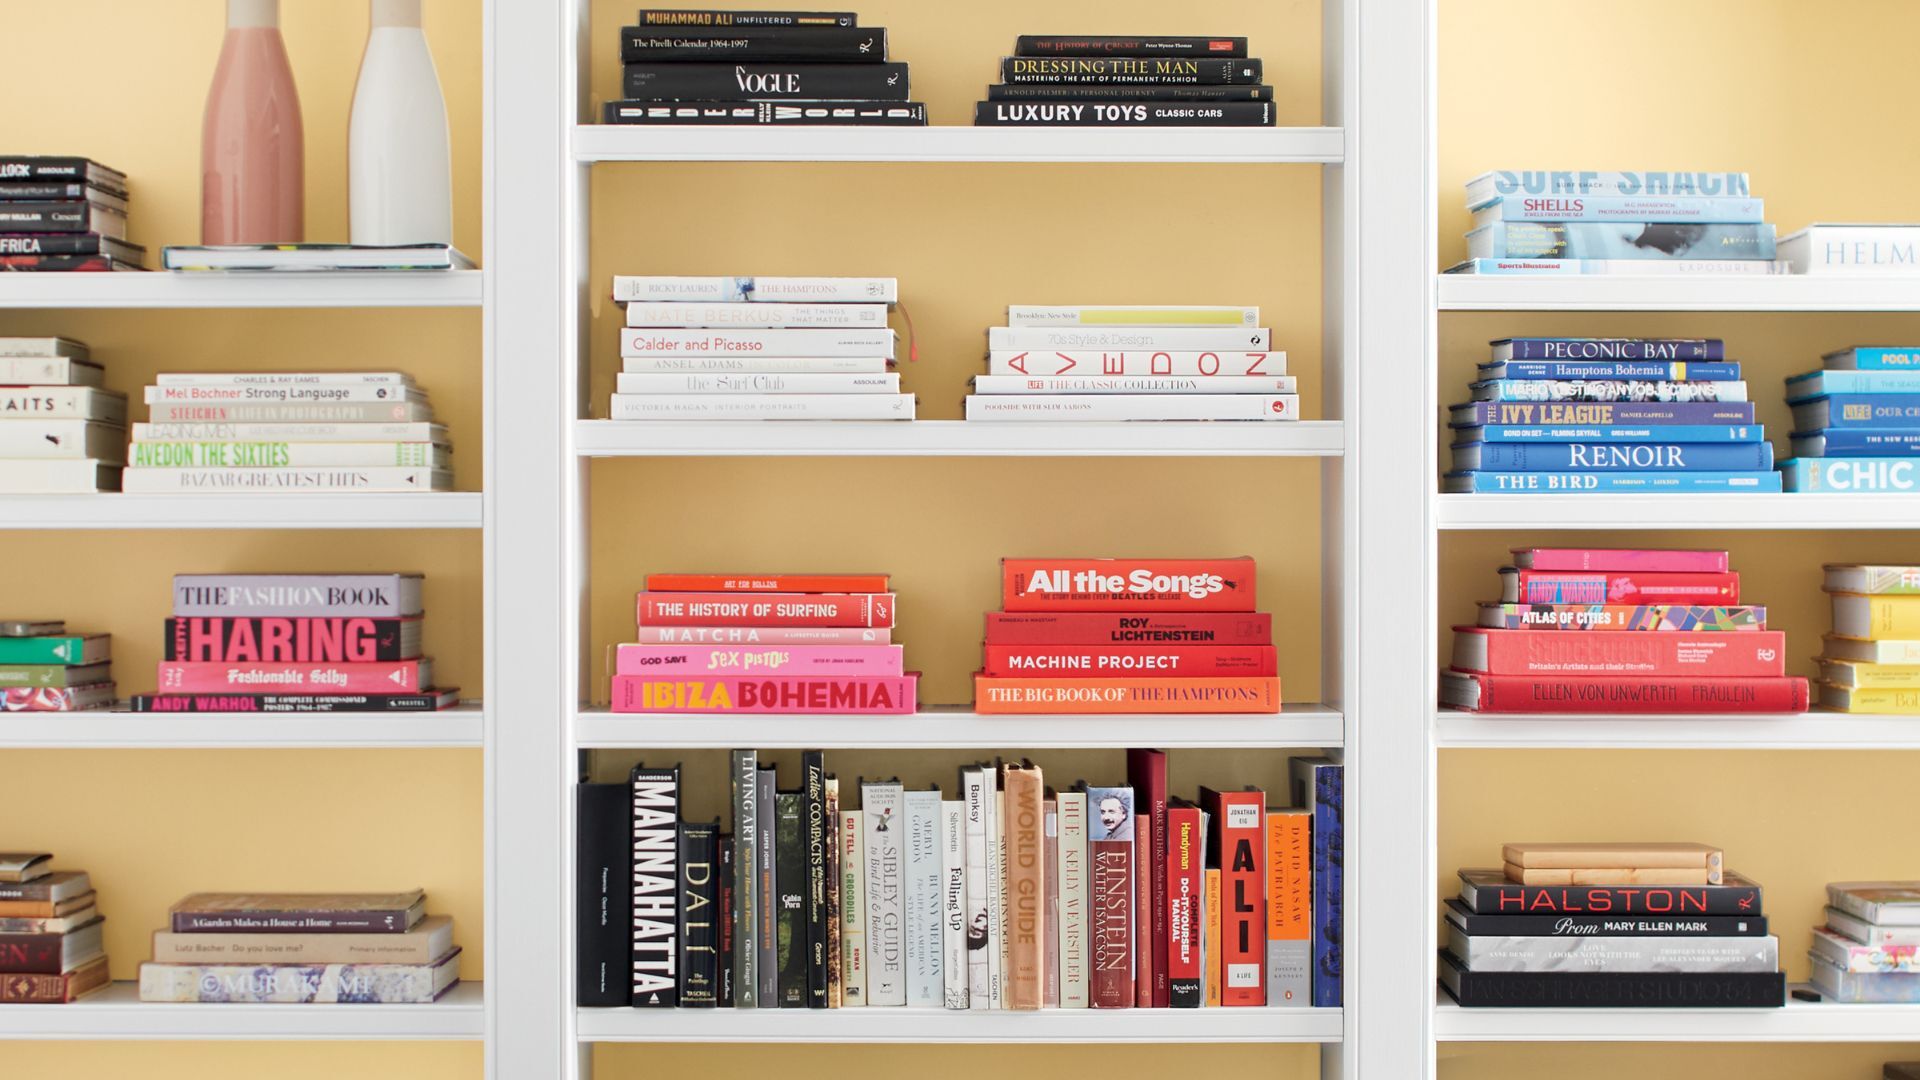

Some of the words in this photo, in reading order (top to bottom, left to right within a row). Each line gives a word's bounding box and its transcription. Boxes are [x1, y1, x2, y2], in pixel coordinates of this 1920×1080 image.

[647, 13, 711, 24] MUHAMMAD
[715, 13, 732, 24] ALI
[633, 39, 648, 48] The
[650, 39, 672, 48] Pirelli
[674, 39, 707, 48] Calendar
[710, 39, 748, 48] 1964-1997
[736, 66, 746, 74] IN
[1014, 60, 1106, 74] DRESSING
[1113, 60, 1148, 74] THE
[1157, 60, 1198, 74] MAN
[736, 74, 800, 93] VOGUE
[997, 105, 1084, 120] LUXURY
[1094, 105, 1147, 120] TOYS
[1156, 109, 1194, 117] CLASSIC
[1198, 109, 1223, 117] CARS
[1495, 171, 1598, 196] SURF
[1618, 171, 1748, 196] SHACK
[1524, 199, 1583, 212] SHELLS
[0, 239, 41, 252] FRICA
[1826, 242, 1913, 264] HELM
[633, 338, 680, 351] Calder
[685, 338, 709, 351] and
[715, 338, 762, 351] Picasso
[1545, 343, 1637, 357] PECONIC
[1645, 343, 1679, 357] BAY
[654, 360, 695, 369] ANSEL
[699, 360, 743, 369] ADAMS
[1008, 352, 1267, 375] AVEDON
[1556, 365, 1613, 377] Hamptons
[1616, 365, 1664, 377] Bohemia
[166, 387, 188, 399] Mel
[192, 387, 241, 399] Bochner
[246, 387, 286, 400] Strong
[290, 387, 349, 400] Language
[687, 376, 710, 390] the
[717, 376, 751, 390] Surf
[754, 376, 784, 390] Club
[1028, 380, 1043, 389] LIFE
[1050, 380, 1071, 389] THE
[1073, 380, 1122, 389] CLASSIC
[1124, 380, 1197, 389] COLLECTION
[1501, 406, 1534, 423] IVY
[1539, 406, 1613, 423] LEAGUE
[136, 443, 193, 465] AVEDON
[200, 443, 227, 465] THE
[233, 443, 288, 465] SIXTIES
[1569, 444, 1685, 466] RENOIR
[181, 472, 235, 486] BAZAAR
[238, 472, 320, 486] GREATEST
[325, 472, 369, 486] HITS
[1496, 476, 1538, 488] THE
[1549, 476, 1598, 488] BIRD
[1826, 462, 1914, 489] CHIC
[1027, 570, 1070, 593] All
[1074, 570, 1123, 593] the
[1128, 570, 1223, 599] Songs
[180, 587, 226, 605] THE
[229, 587, 325, 605] FASHION
[328, 587, 389, 605] BOOK
[657, 603, 683, 617] THE
[690, 603, 749, 617] HISTORY
[753, 603, 770, 617] OF
[777, 603, 837, 617] SURFING
[1522, 612, 1556, 624] ATLAS
[1560, 612, 1574, 624] OF
[1577, 612, 1611, 624] CITIES
[1120, 619, 1150, 628] ROY
[190, 618, 376, 661] HARING
[659, 629, 760, 642] MATCHA
[1112, 631, 1214, 640] LICHTENSTEIN
[641, 657, 662, 665] GOD
[1009, 656, 1091, 668] MACHINE
[1099, 656, 1179, 668] PROJECT
[227, 670, 303, 685] Fashionable
[310, 670, 347, 685] Selby
[643, 681, 732, 708] IBIZA
[738, 681, 893, 708] BOHEMIA
[989, 688, 1027, 702] THE
[1029, 688, 1052, 702] BIG
[1053, 688, 1103, 702] BOOK
[1105, 688, 1126, 702] OF
[1130, 688, 1161, 702] THE
[1168, 688, 1258, 702] HAMPTONS
[1534, 684, 1571, 701] ELLEN
[1578, 684, 1604, 701] VON
[1610, 684, 1677, 701] UNWERTH
[1693, 684, 1754, 701] FRÄULEIN
[152, 697, 191, 711] ANDY
[196, 697, 258, 711] WARHOL
[743, 757, 753, 810] LIVING
[809, 765, 820, 800] Ladies'
[970, 785, 980, 823] Banksy
[1018, 789, 1035, 868] WORLD
[1065, 801, 1080, 835] HUE
[743, 815, 753, 844] ART
[811, 803, 822, 864] COMPACTS
[913, 815, 921, 863] GORDON
[923, 821, 931, 858] MERYL
[950, 812, 958, 852] Silverstein
[1274, 825, 1283, 845] The
[1180, 823, 1190, 870] Handyman
[1292, 827, 1301, 870] DAVID
[883, 847, 897, 907] SIBLEY
[1066, 850, 1080, 890] KELLY
[1096, 851, 1106, 904] WALTER
[634, 782, 675, 993] MANNAHATTA
[871, 882, 880, 900] Life
[929, 875, 938, 915] BUNNY
[947, 868, 961, 910] Falling
[1232, 839, 1255, 953] ALI
[1274, 851, 1283, 927] PATRIARCH
[686, 863, 715, 954] DALÍ
[871, 903, 880, 911] &
[1106, 851, 1127, 971] EINSTEIN
[1292, 879, 1301, 923] NASAW
[1500, 889, 1707, 911] HALSTON
[949, 913, 961, 931] Up
[1018, 879, 1035, 944] GUIDE
[1172, 900, 1180, 942] MANUAL
[1180, 878, 1189, 964] DO-IT-YOURSELF
[872, 915, 880, 955] Behavior
[1552, 917, 1600, 935] Prom
[1604, 922, 1635, 931] MARY
[1639, 922, 1673, 931] ELLEN
[1676, 922, 1707, 931] MARK
[884, 913, 898, 972] GUIDE
[930, 919, 939, 976] MELLON
[1067, 899, 1080, 983] WEARSTLER
[1096, 907, 1106, 971] ISAACSON
